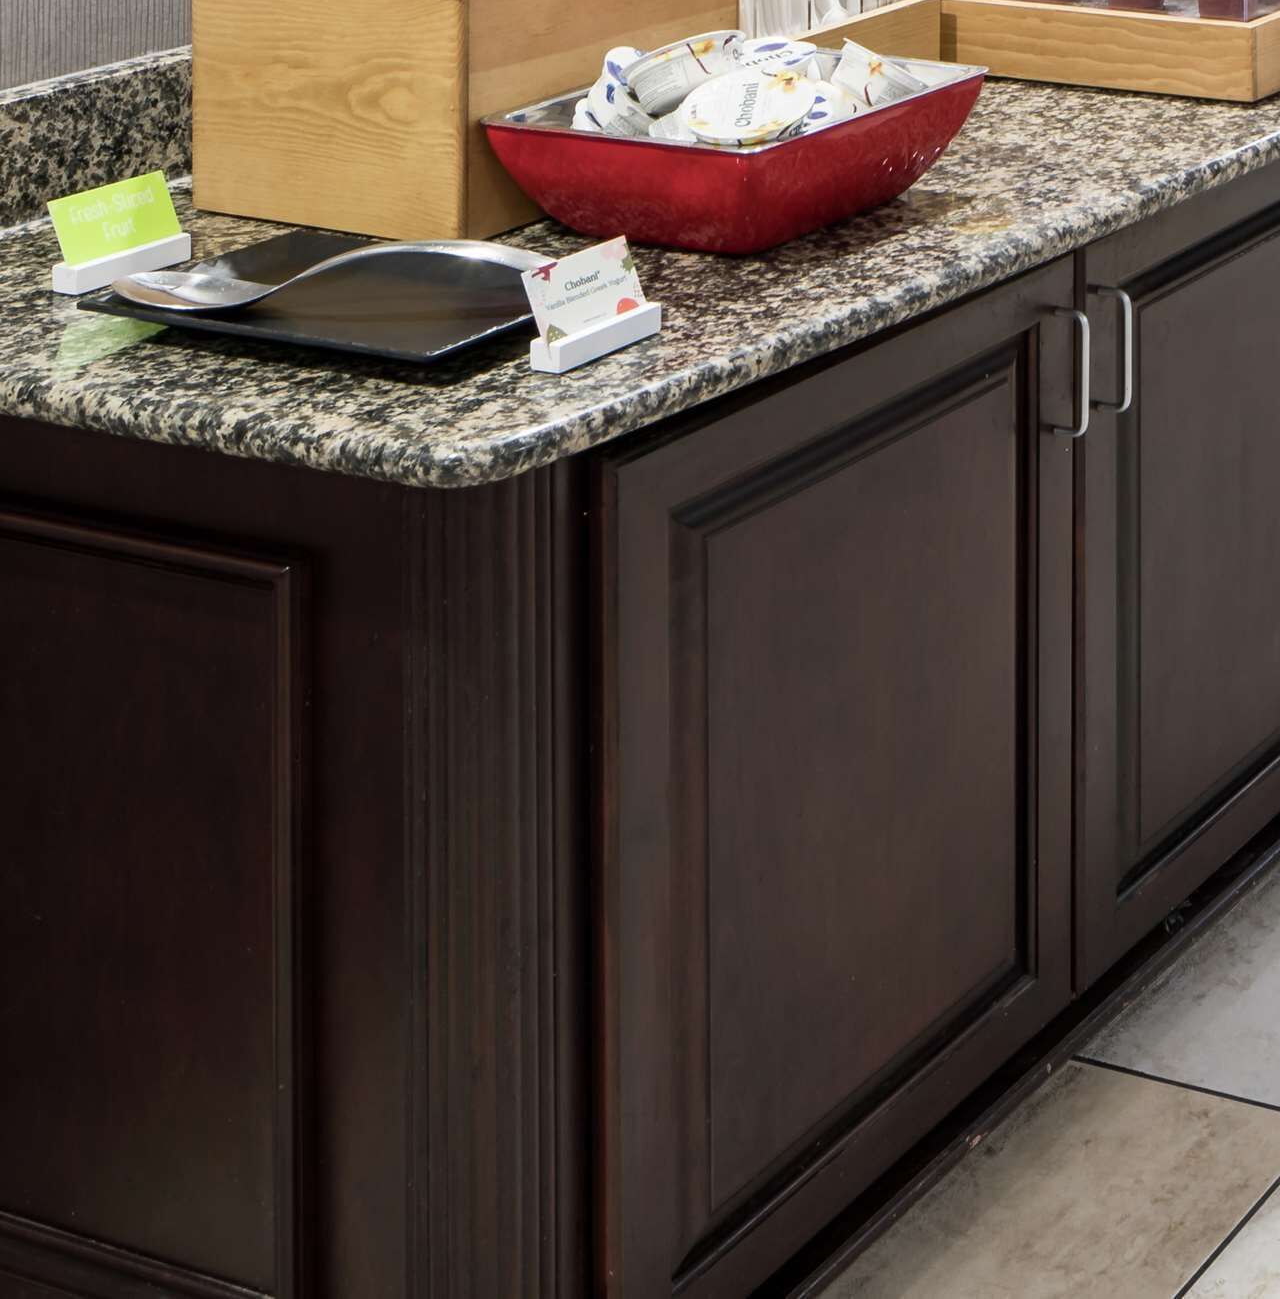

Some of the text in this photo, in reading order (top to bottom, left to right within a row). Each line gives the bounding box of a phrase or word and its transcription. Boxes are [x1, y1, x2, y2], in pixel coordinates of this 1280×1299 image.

[734, 81, 760, 128] Chobani
[101, 218, 137, 243] Fruit
[566, 287, 590, 304] Blended
